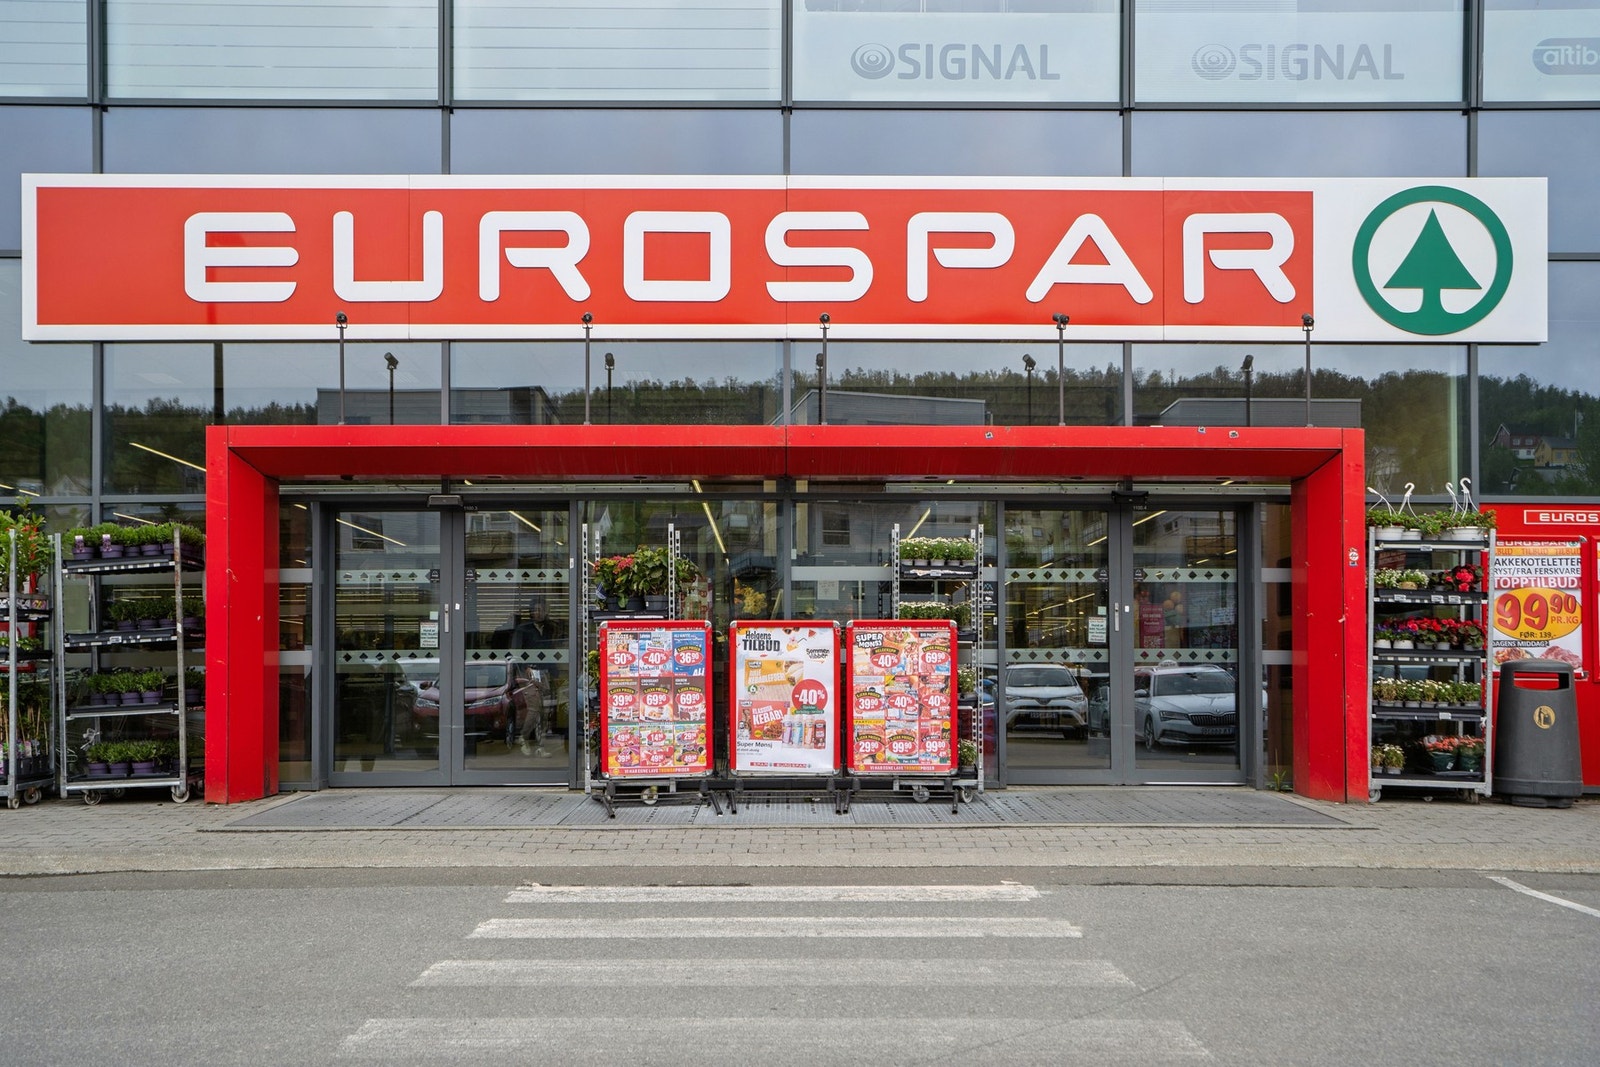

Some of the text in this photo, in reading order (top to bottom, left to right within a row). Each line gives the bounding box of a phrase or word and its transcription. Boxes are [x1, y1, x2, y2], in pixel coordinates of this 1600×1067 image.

[1543, 44, 1600, 66] altib
[897, 43, 1060, 80] SIGNAL
[1238, 43, 1405, 80] SIGNAL
[184, 210, 1297, 304] EUROSPAR
[1539, 513, 1599, 522] EUROS
[1534, 567, 1580, 576] FERSKVARE
[1494, 577, 1577, 588] TOPPTILBUD
[745, 631, 771, 640] Helgens
[856, 633, 883, 642] SUPER
[742, 639, 780, 652] TILBUD
[609, 653, 632, 664] -50%
[644, 653, 666, 664] -40%
[873, 654, 898, 667] -40%
[795, 689, 825, 705] -40%
[890, 696, 912, 707] -40%
[923, 695, 946, 707] -40%
[753, 709, 784, 725] KEBAB!
